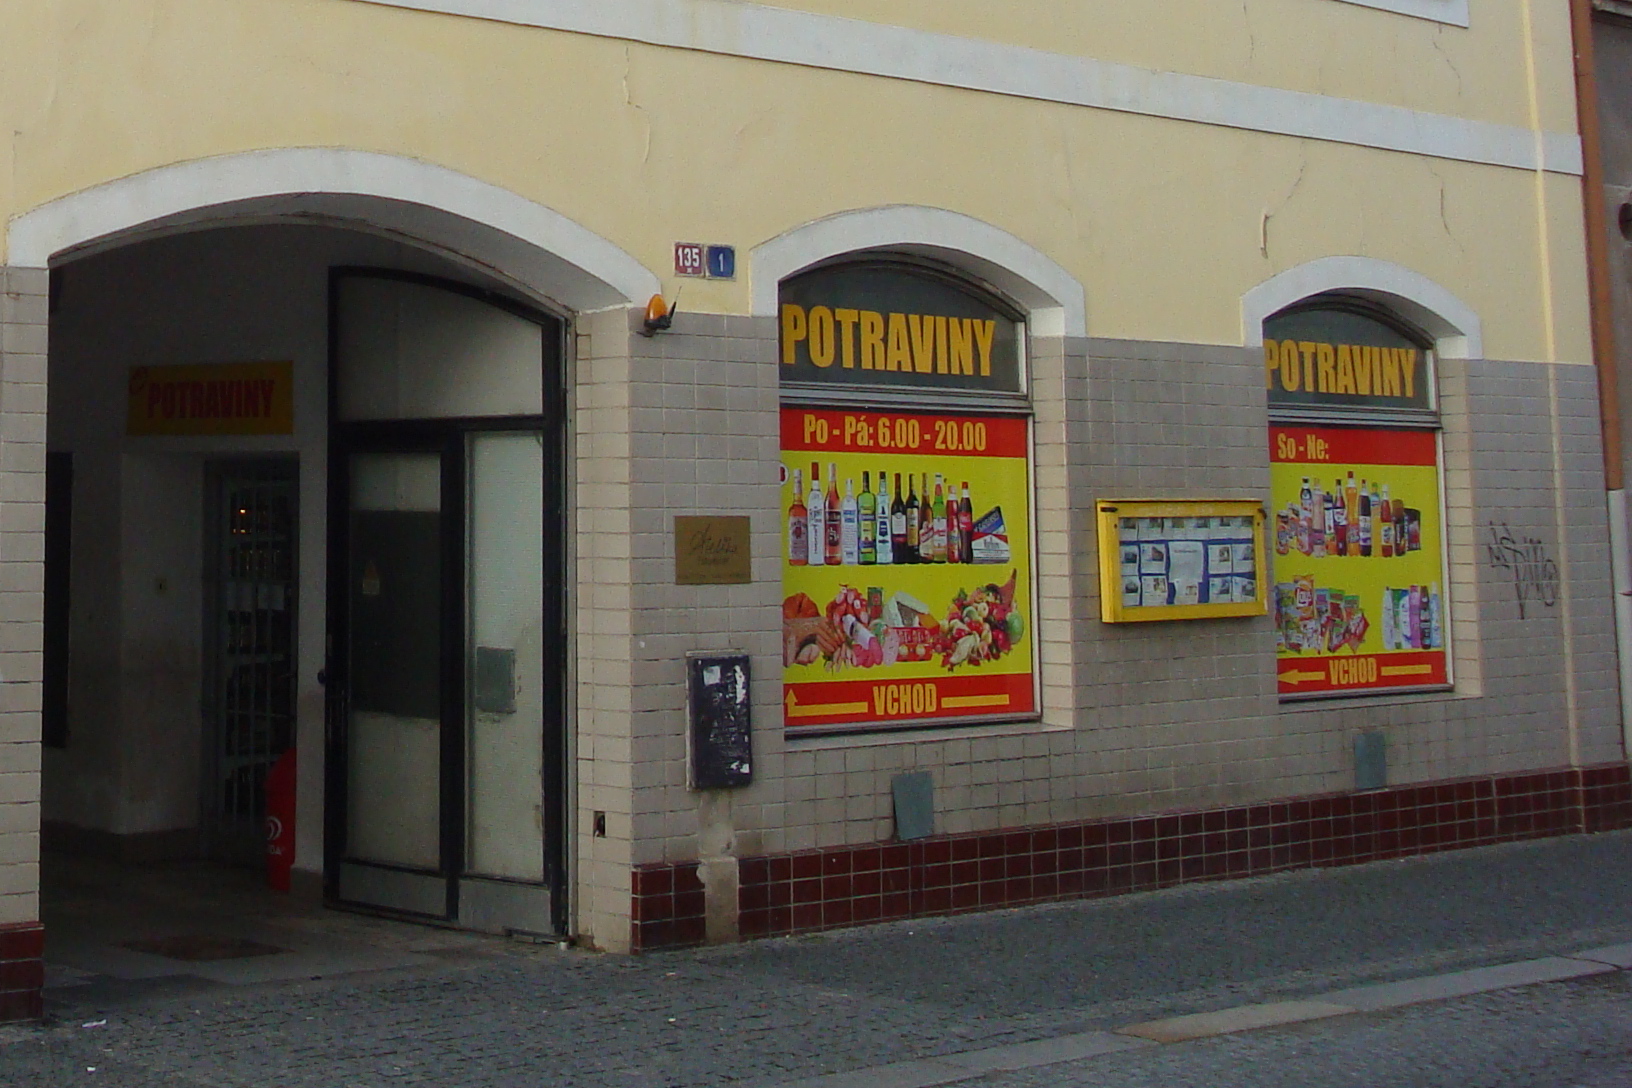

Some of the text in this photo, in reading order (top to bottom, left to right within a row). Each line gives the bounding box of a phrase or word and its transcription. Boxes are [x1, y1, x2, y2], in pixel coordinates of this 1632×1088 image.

[678, 247, 701, 268] 135
[718, 253, 725, 272] 1
[782, 304, 996, 377] POTRAVINY
[1263, 338, 1417, 398] POTRAVINY
[147, 379, 275, 419] POTRAVINY
[803, 413, 829, 444] Po
[878, 417, 921, 449] 6.00
[935, 420, 987, 452] 20.00
[1277, 433, 1296, 459] So
[1329, 657, 1378, 686] VCHOD
[873, 683, 938, 716] VCHOD
